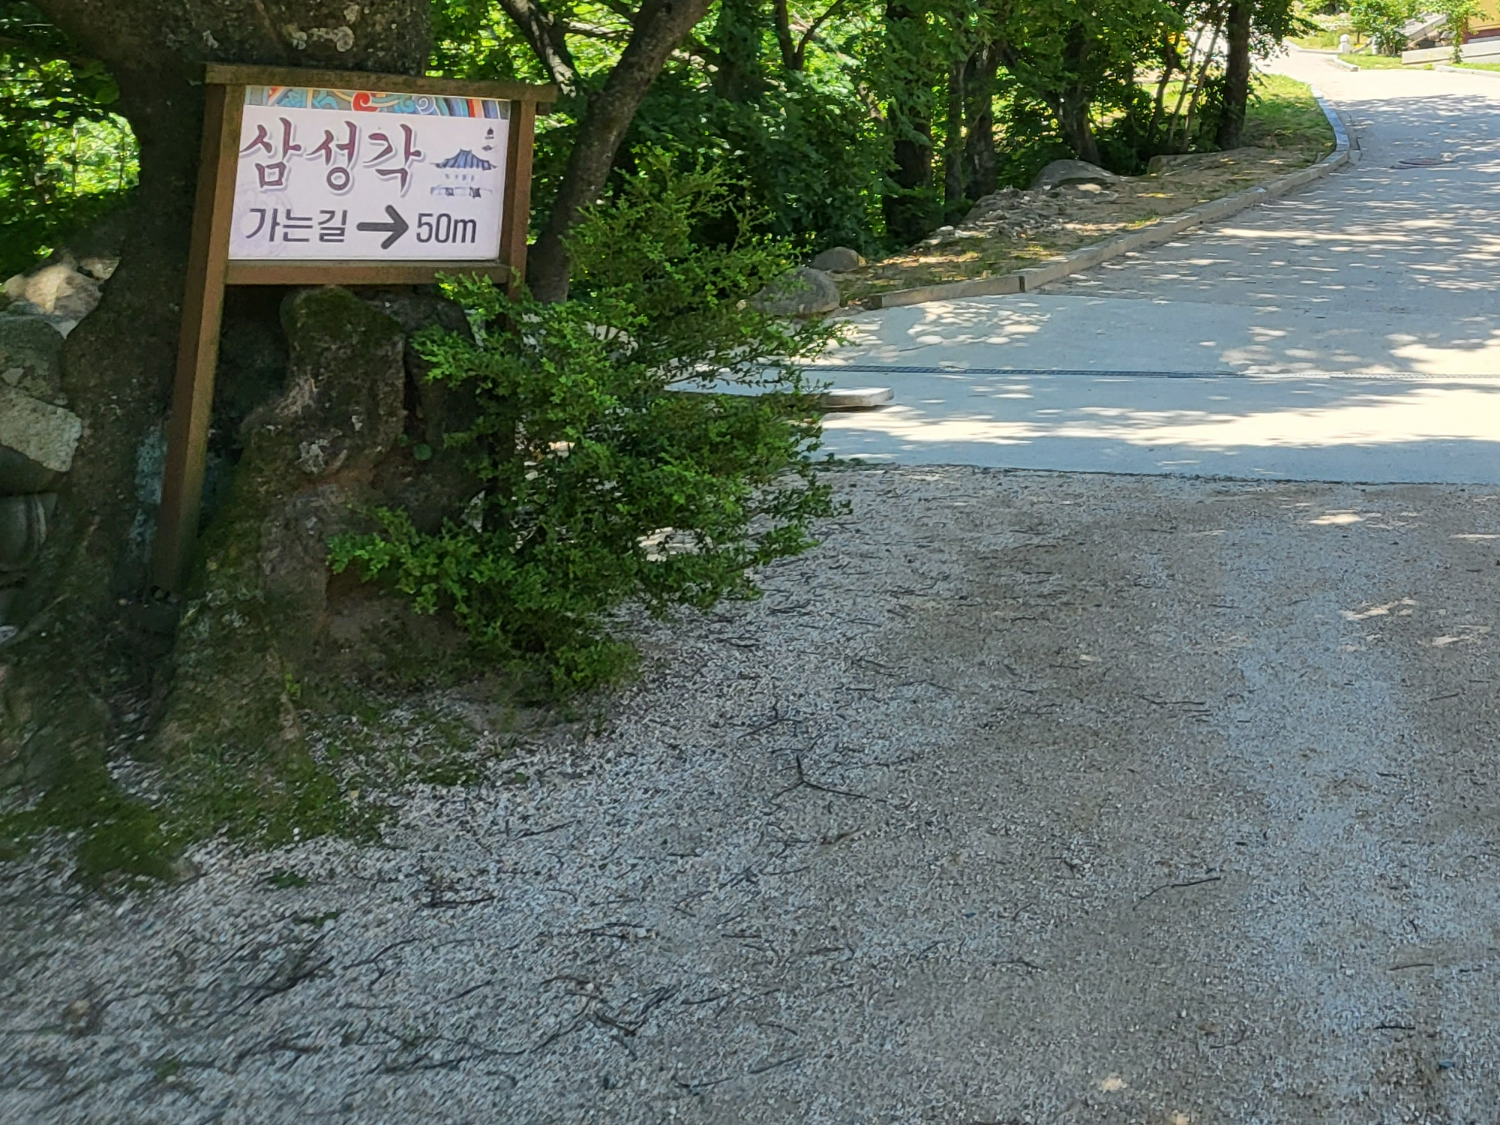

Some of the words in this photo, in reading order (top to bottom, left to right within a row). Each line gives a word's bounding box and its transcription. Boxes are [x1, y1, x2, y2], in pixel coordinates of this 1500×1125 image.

[239, 116, 422, 193] 삼성각
[245, 208, 348, 243] 가는길
[416, 212, 477, 244] 50m
